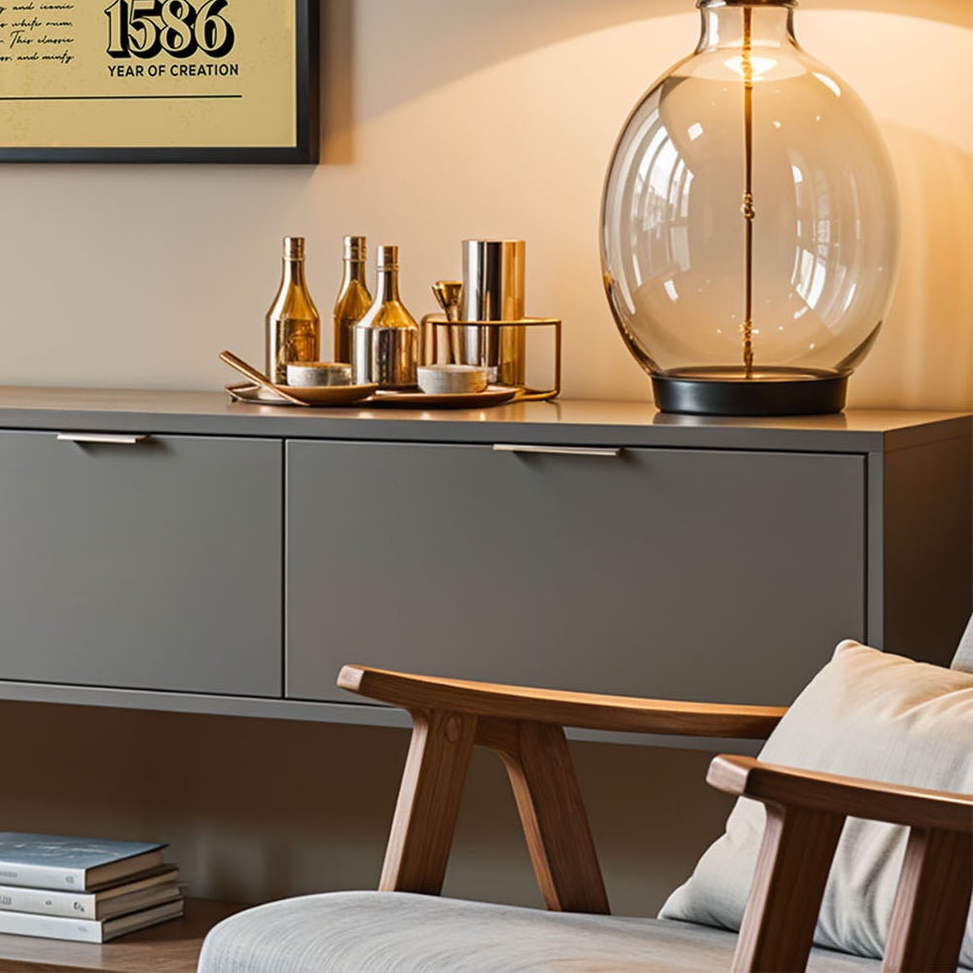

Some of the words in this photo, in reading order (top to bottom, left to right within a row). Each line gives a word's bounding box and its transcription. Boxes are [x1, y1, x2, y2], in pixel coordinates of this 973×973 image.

[12, 2, 35, 11] and
[40, 3, 75, 11] iconic
[12, 17, 42, 31] white
[10, 30, 34, 49] This
[37, 35, 75, 45] classic
[17, 52, 39, 61] and
[41, 49, 75, 64] minty
[107, 64, 144, 77] YEAR
[148, 64, 166, 77] OF
[170, 63, 239, 76] CREATION
